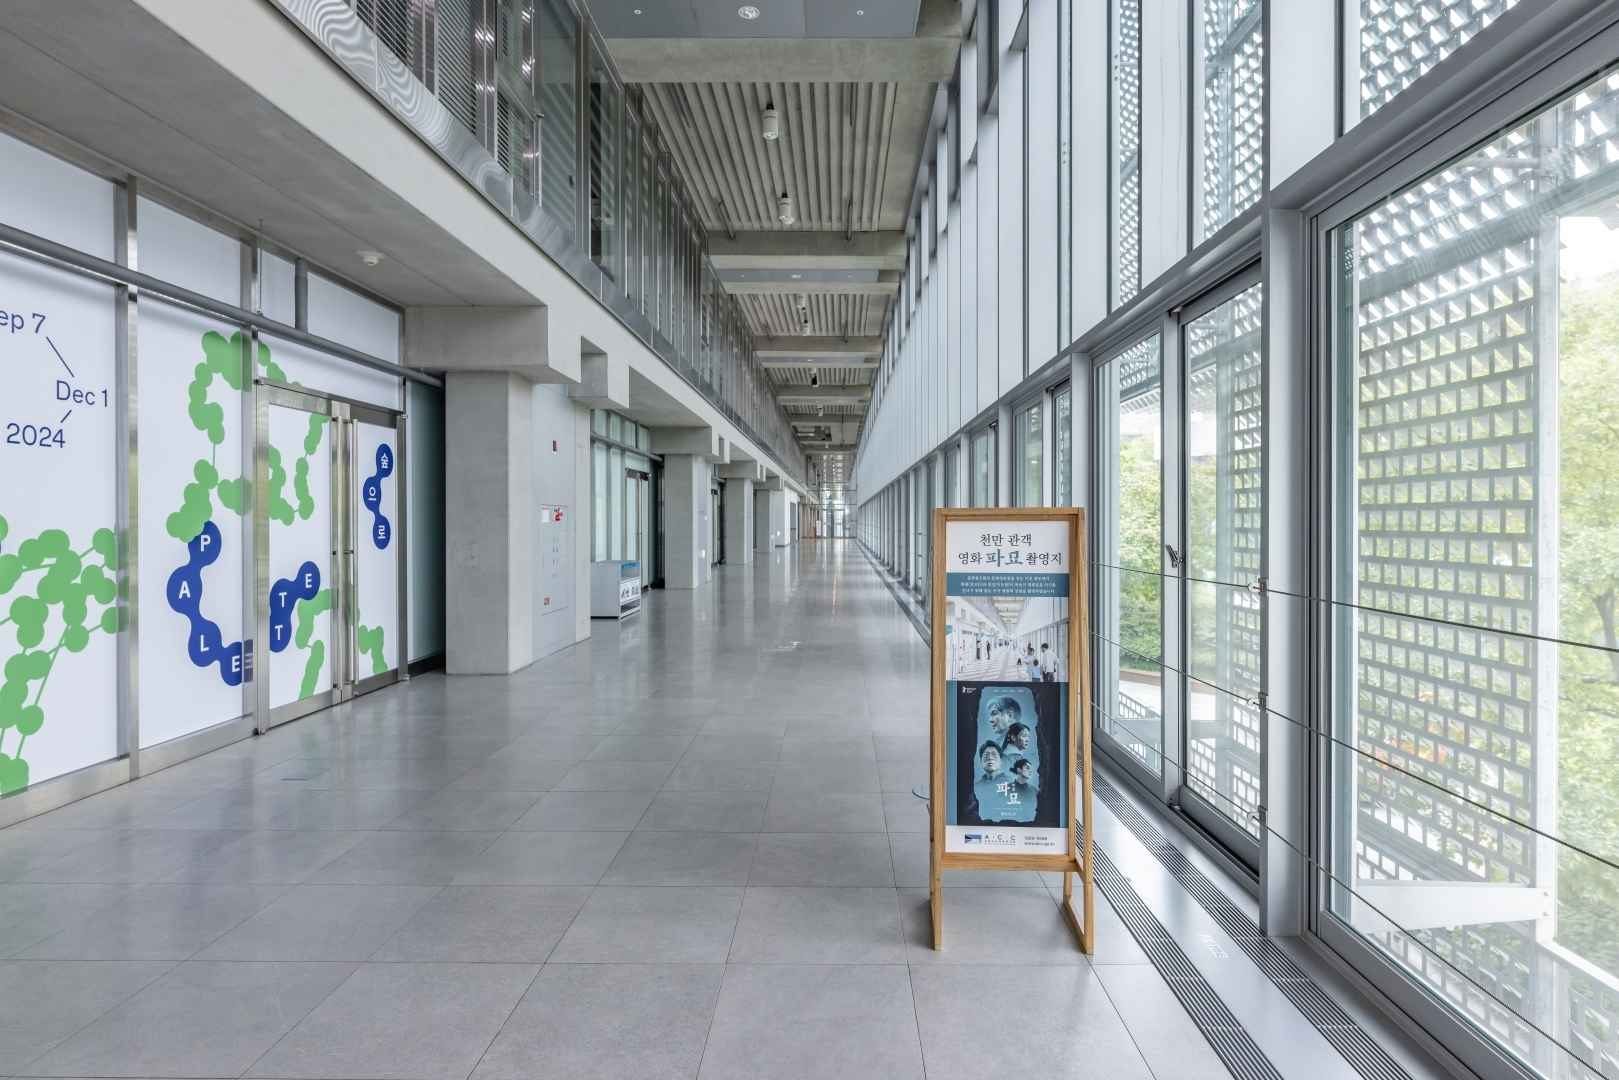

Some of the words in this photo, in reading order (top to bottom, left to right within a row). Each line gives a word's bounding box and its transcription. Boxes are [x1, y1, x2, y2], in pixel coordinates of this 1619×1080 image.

[0, 310, 25, 333] ep
[32, 313, 46, 333] 7
[56, 380, 96, 406] Dec
[102, 388, 108, 408] 1
[6, 423, 66, 448] 2024
[979, 533, 1003, 547] 천만
[1007, 533, 1032, 547] 관객
[958, 552, 983, 565] 영화
[985, 548, 1023, 567] 파묘
[1026, 552, 1063, 565] 촬영지
